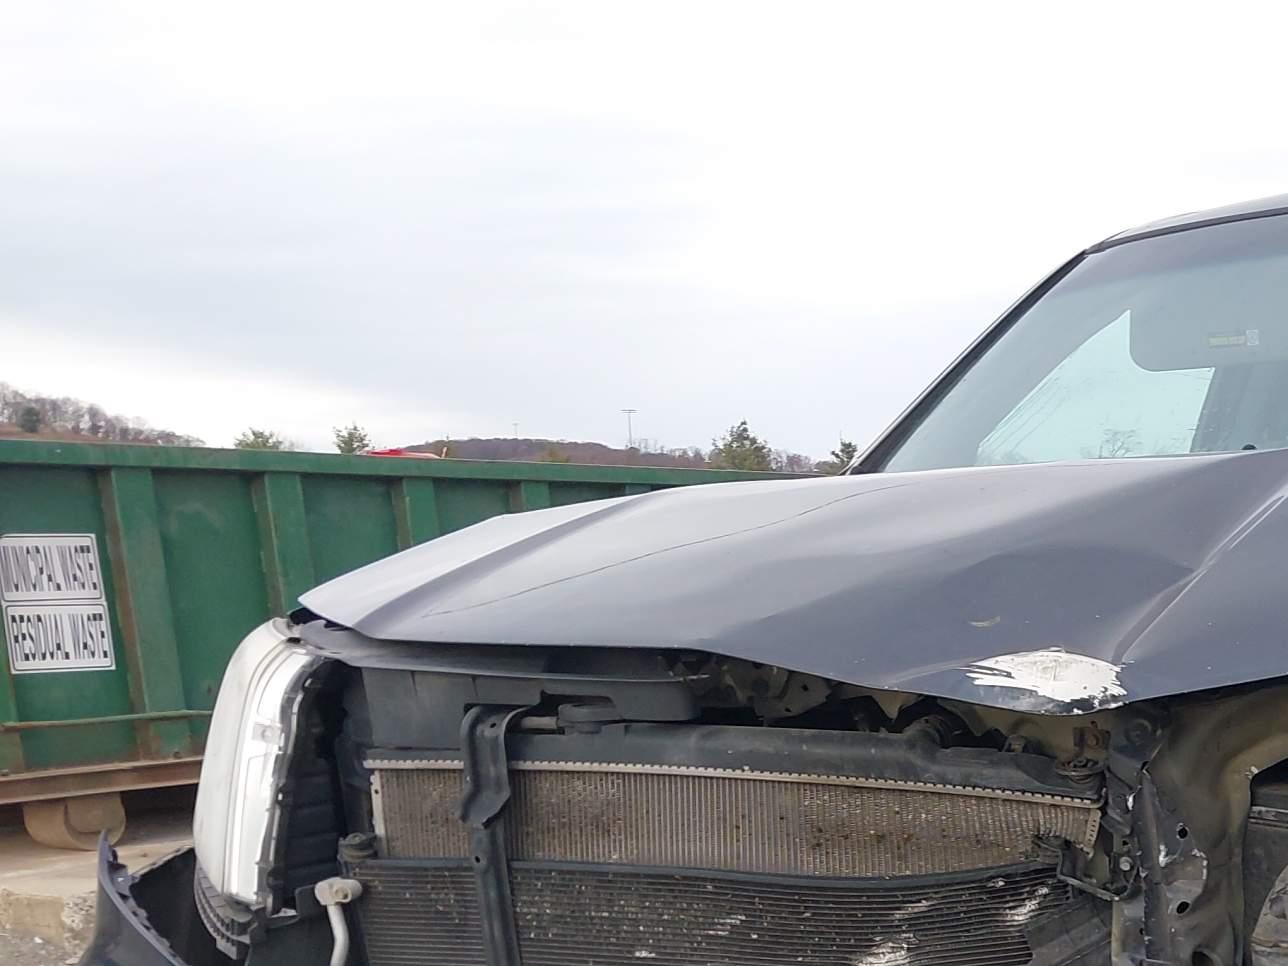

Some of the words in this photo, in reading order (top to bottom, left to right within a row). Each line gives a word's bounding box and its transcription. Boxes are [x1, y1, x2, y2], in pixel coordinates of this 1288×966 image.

[56, 544, 97, 591] WASTE
[10, 614, 70, 662] RESIDUAL
[68, 613, 108, 660] WASTE
